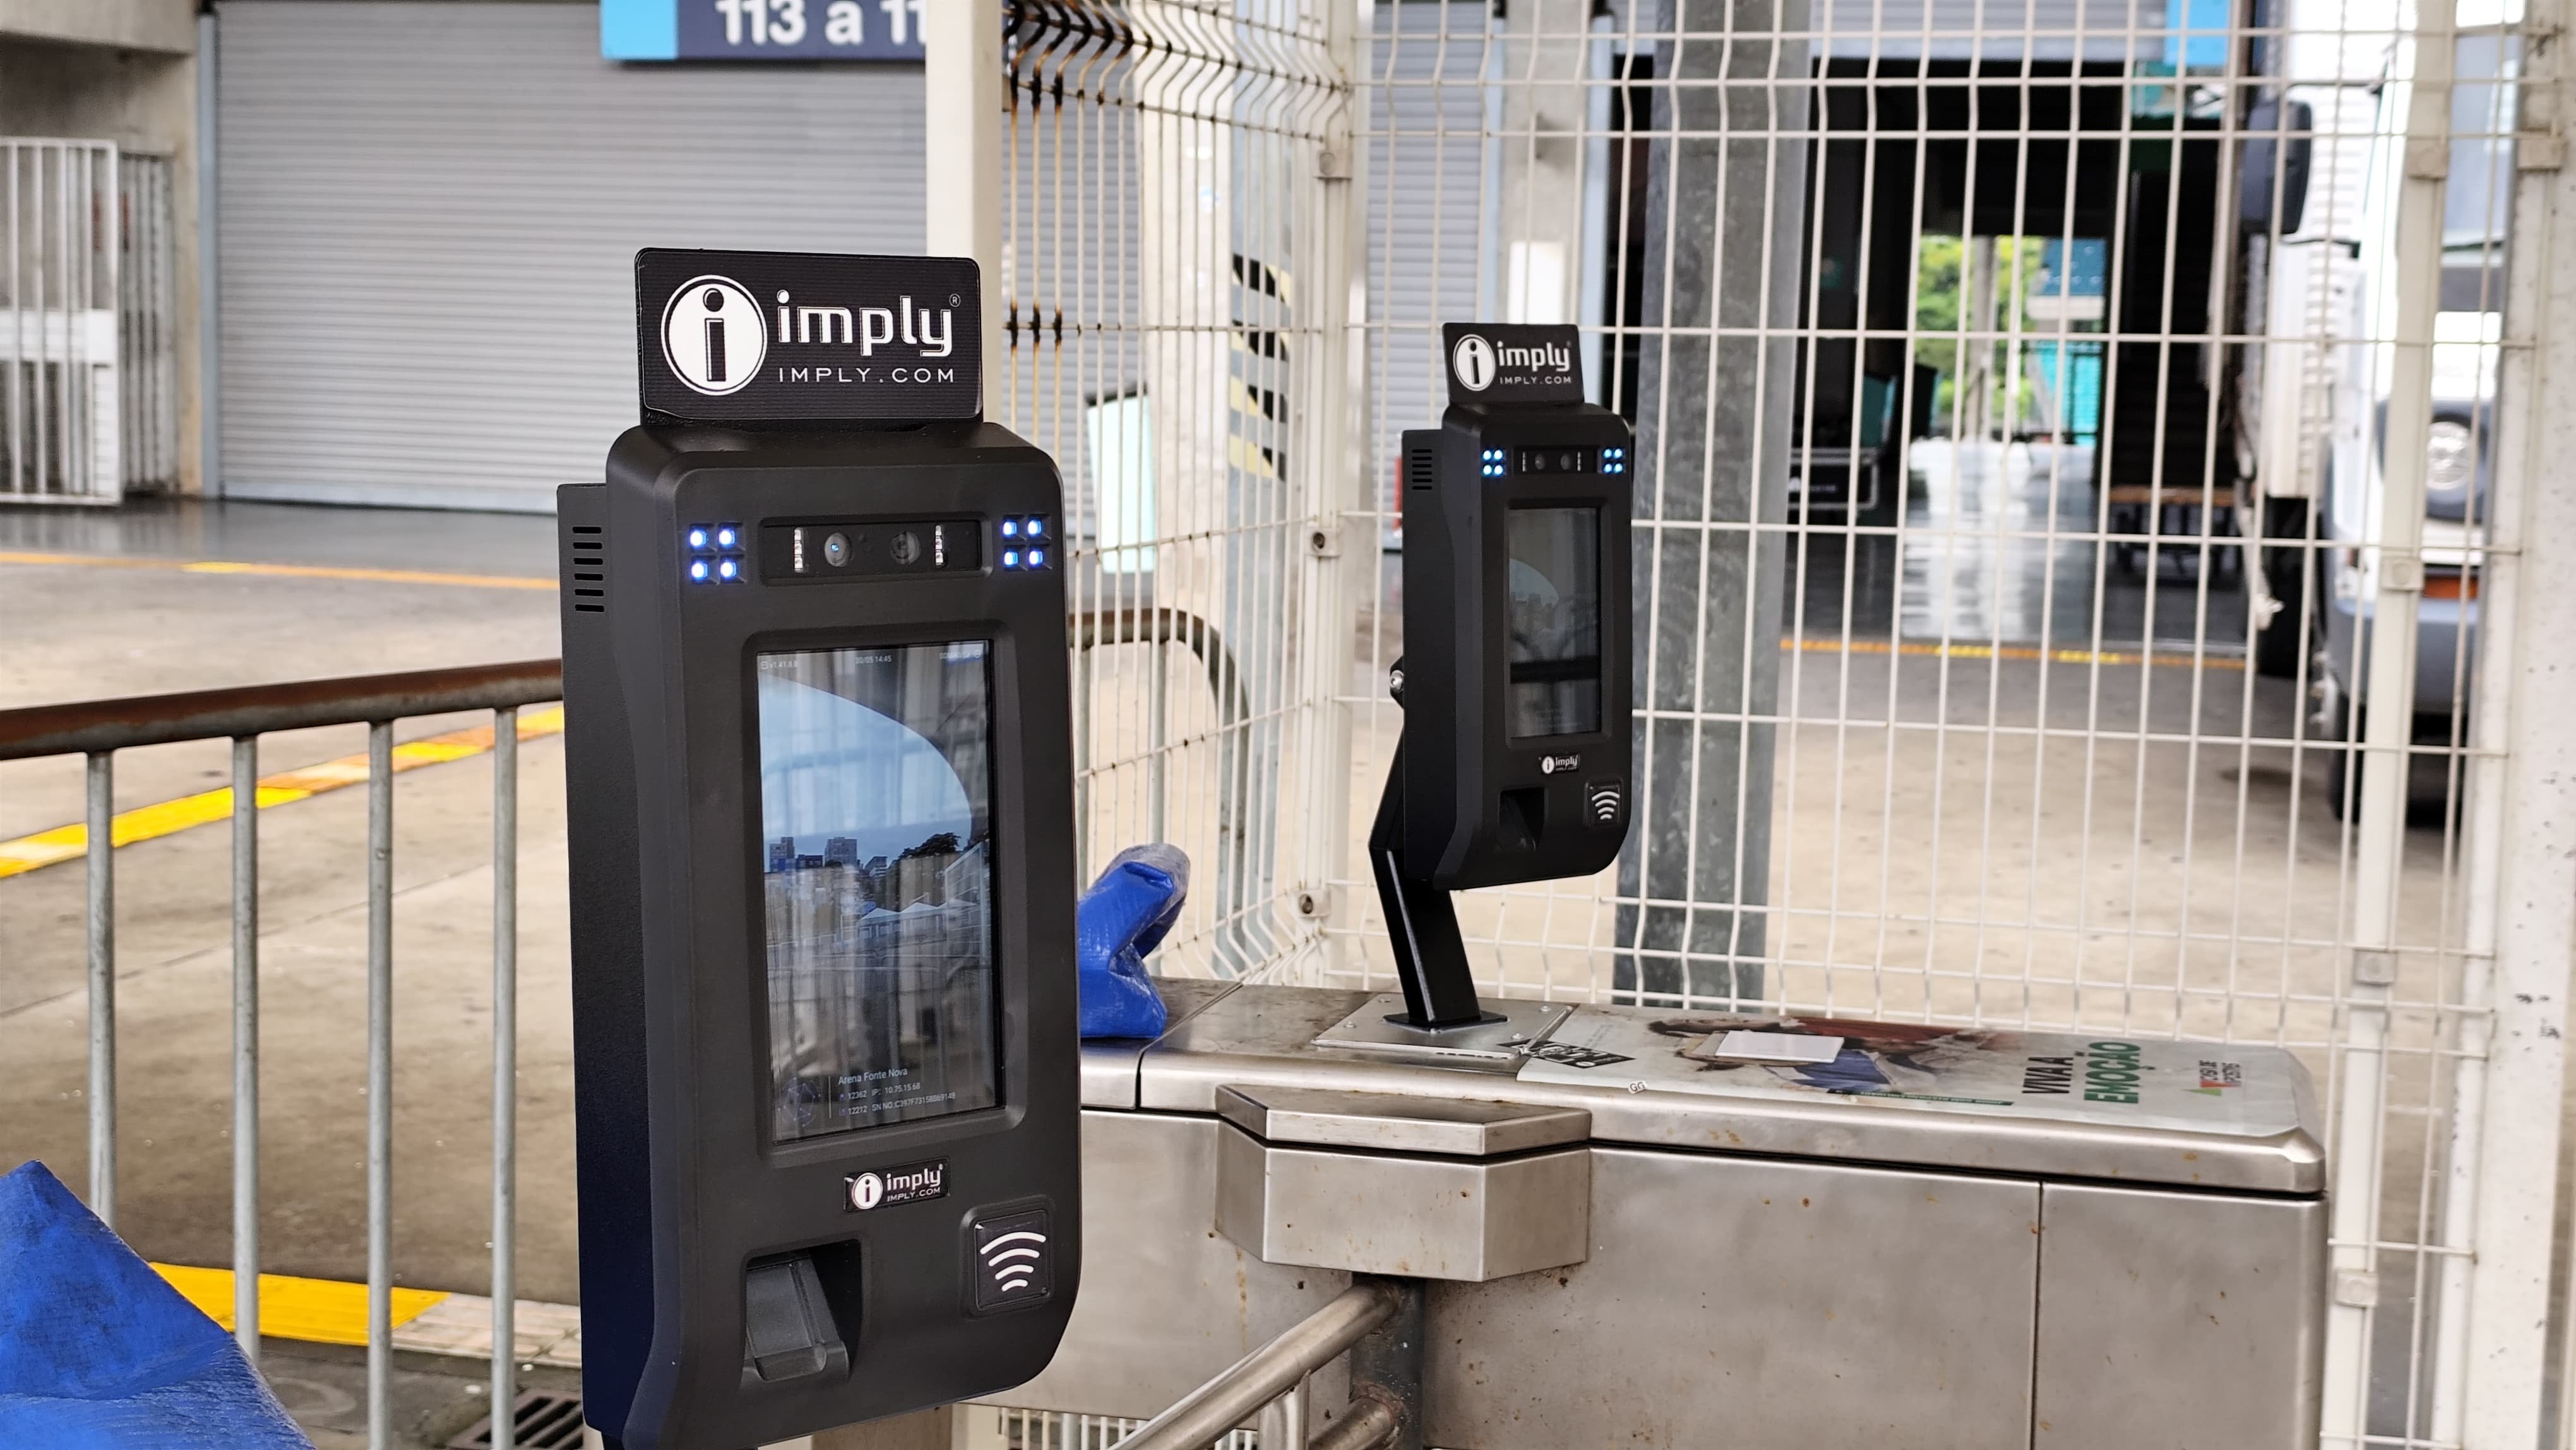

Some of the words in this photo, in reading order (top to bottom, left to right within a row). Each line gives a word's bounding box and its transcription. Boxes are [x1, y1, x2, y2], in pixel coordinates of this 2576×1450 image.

[715, 0, 806, 45] 113
[825, 1, 864, 45] a
[778, 367, 955, 384] IMPLY.COM
[1500, 376, 1571, 385] IMPLY.COM
[838, 1076, 861, 1085] Arena
[864, 1071, 886, 1082] Fonte
[888, 1068, 908, 1077] Nova
[2022, 1067, 2073, 1094] VIVA
[2075, 1041, 2156, 1104] EMOÇÃO
[886, 1168, 941, 1191] imply
[887, 1187, 941, 1202] IMPLY.COM
